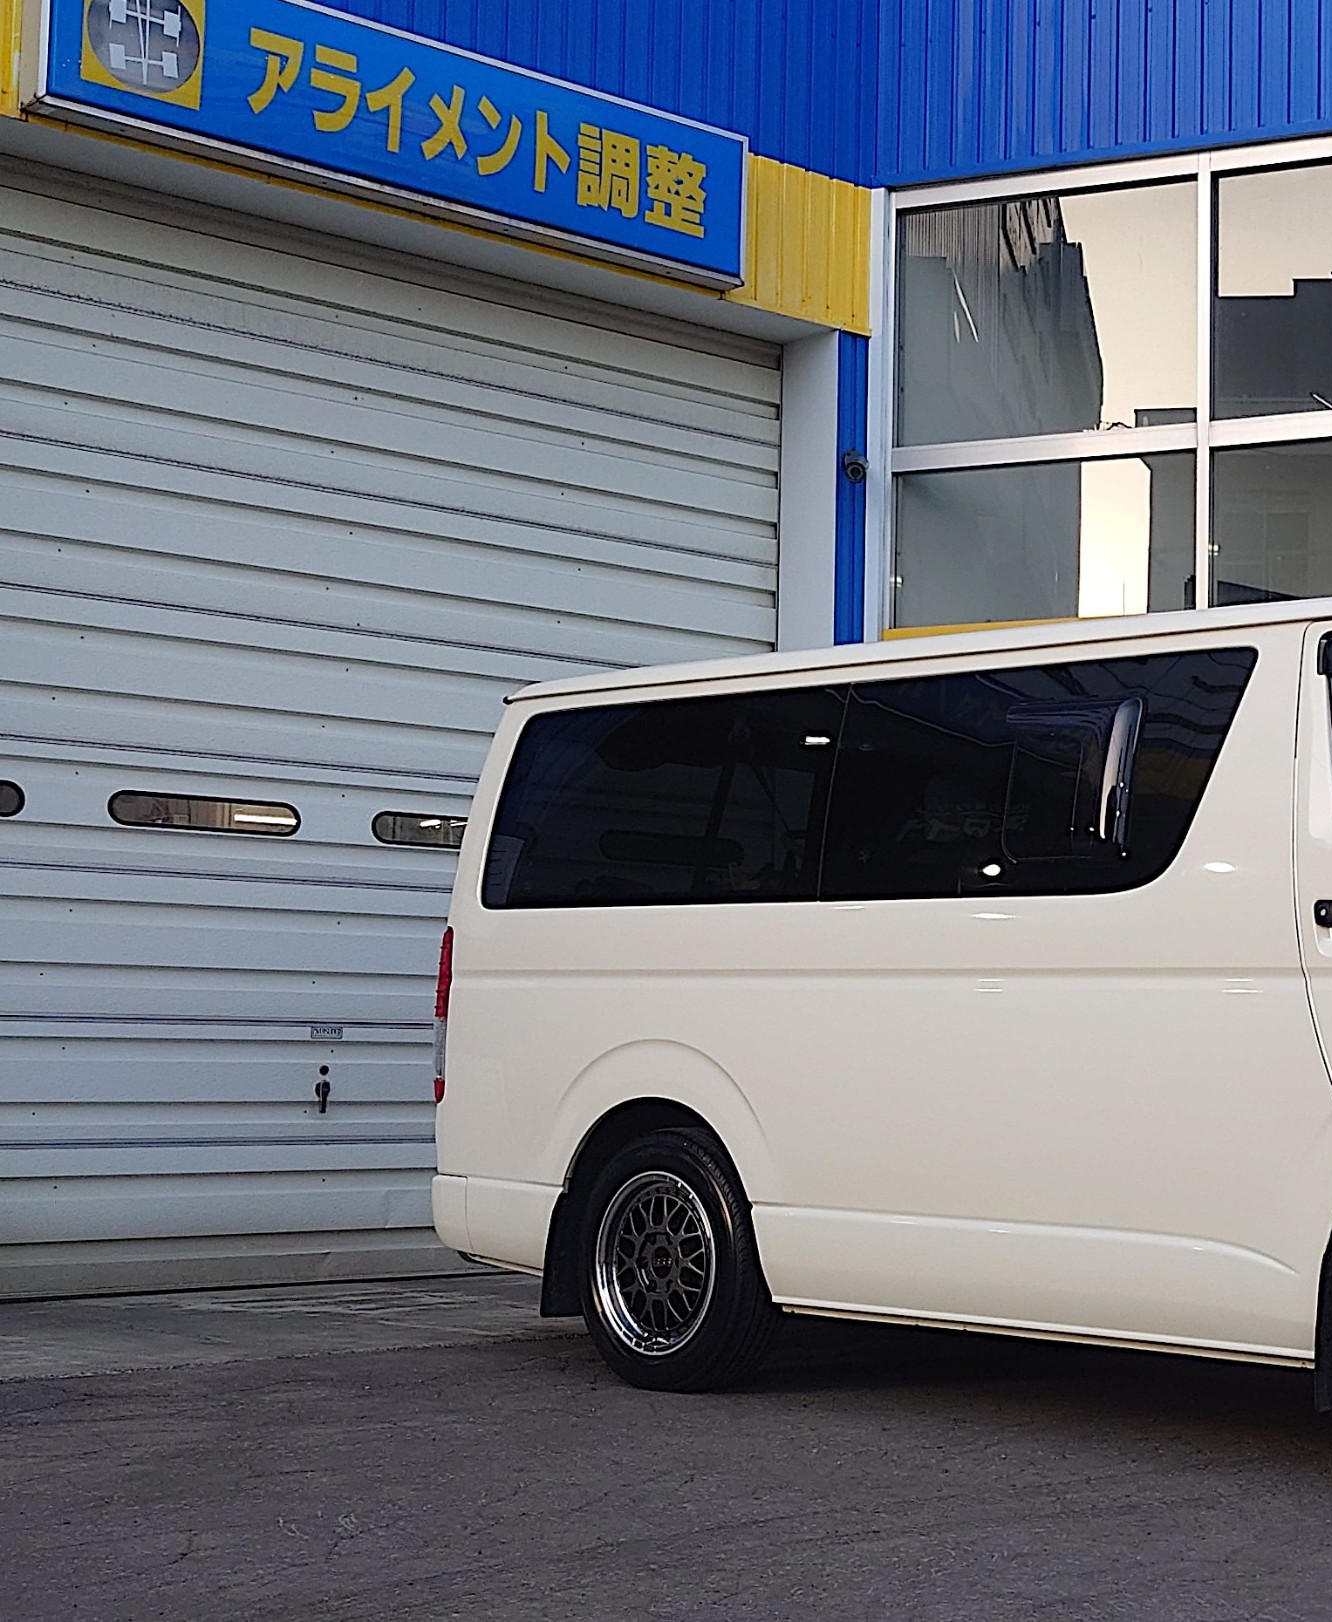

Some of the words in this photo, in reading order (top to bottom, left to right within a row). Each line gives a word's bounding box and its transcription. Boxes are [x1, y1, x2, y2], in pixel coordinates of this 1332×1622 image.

[246, 27, 706, 239] アライメント調整
